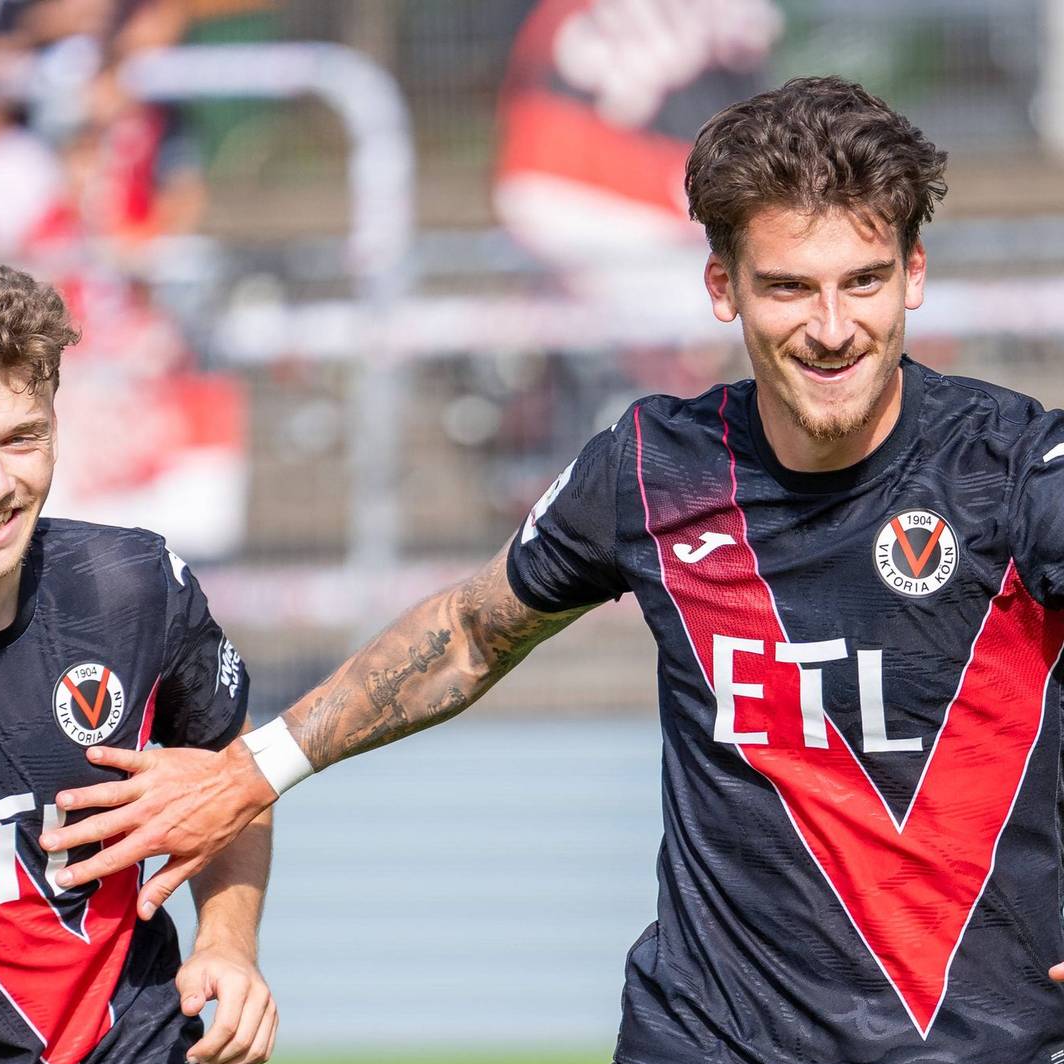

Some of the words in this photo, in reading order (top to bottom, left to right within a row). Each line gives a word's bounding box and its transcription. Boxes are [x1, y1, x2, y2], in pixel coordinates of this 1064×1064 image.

[907, 515, 932, 526] 1904
[878, 543, 930, 593] VIKTORIA
[934, 546, 954, 584] KÖLN
[74, 666, 98, 679] 1904
[712, 634, 924, 753] ETL
[59, 702, 104, 744] VIKTORIA
